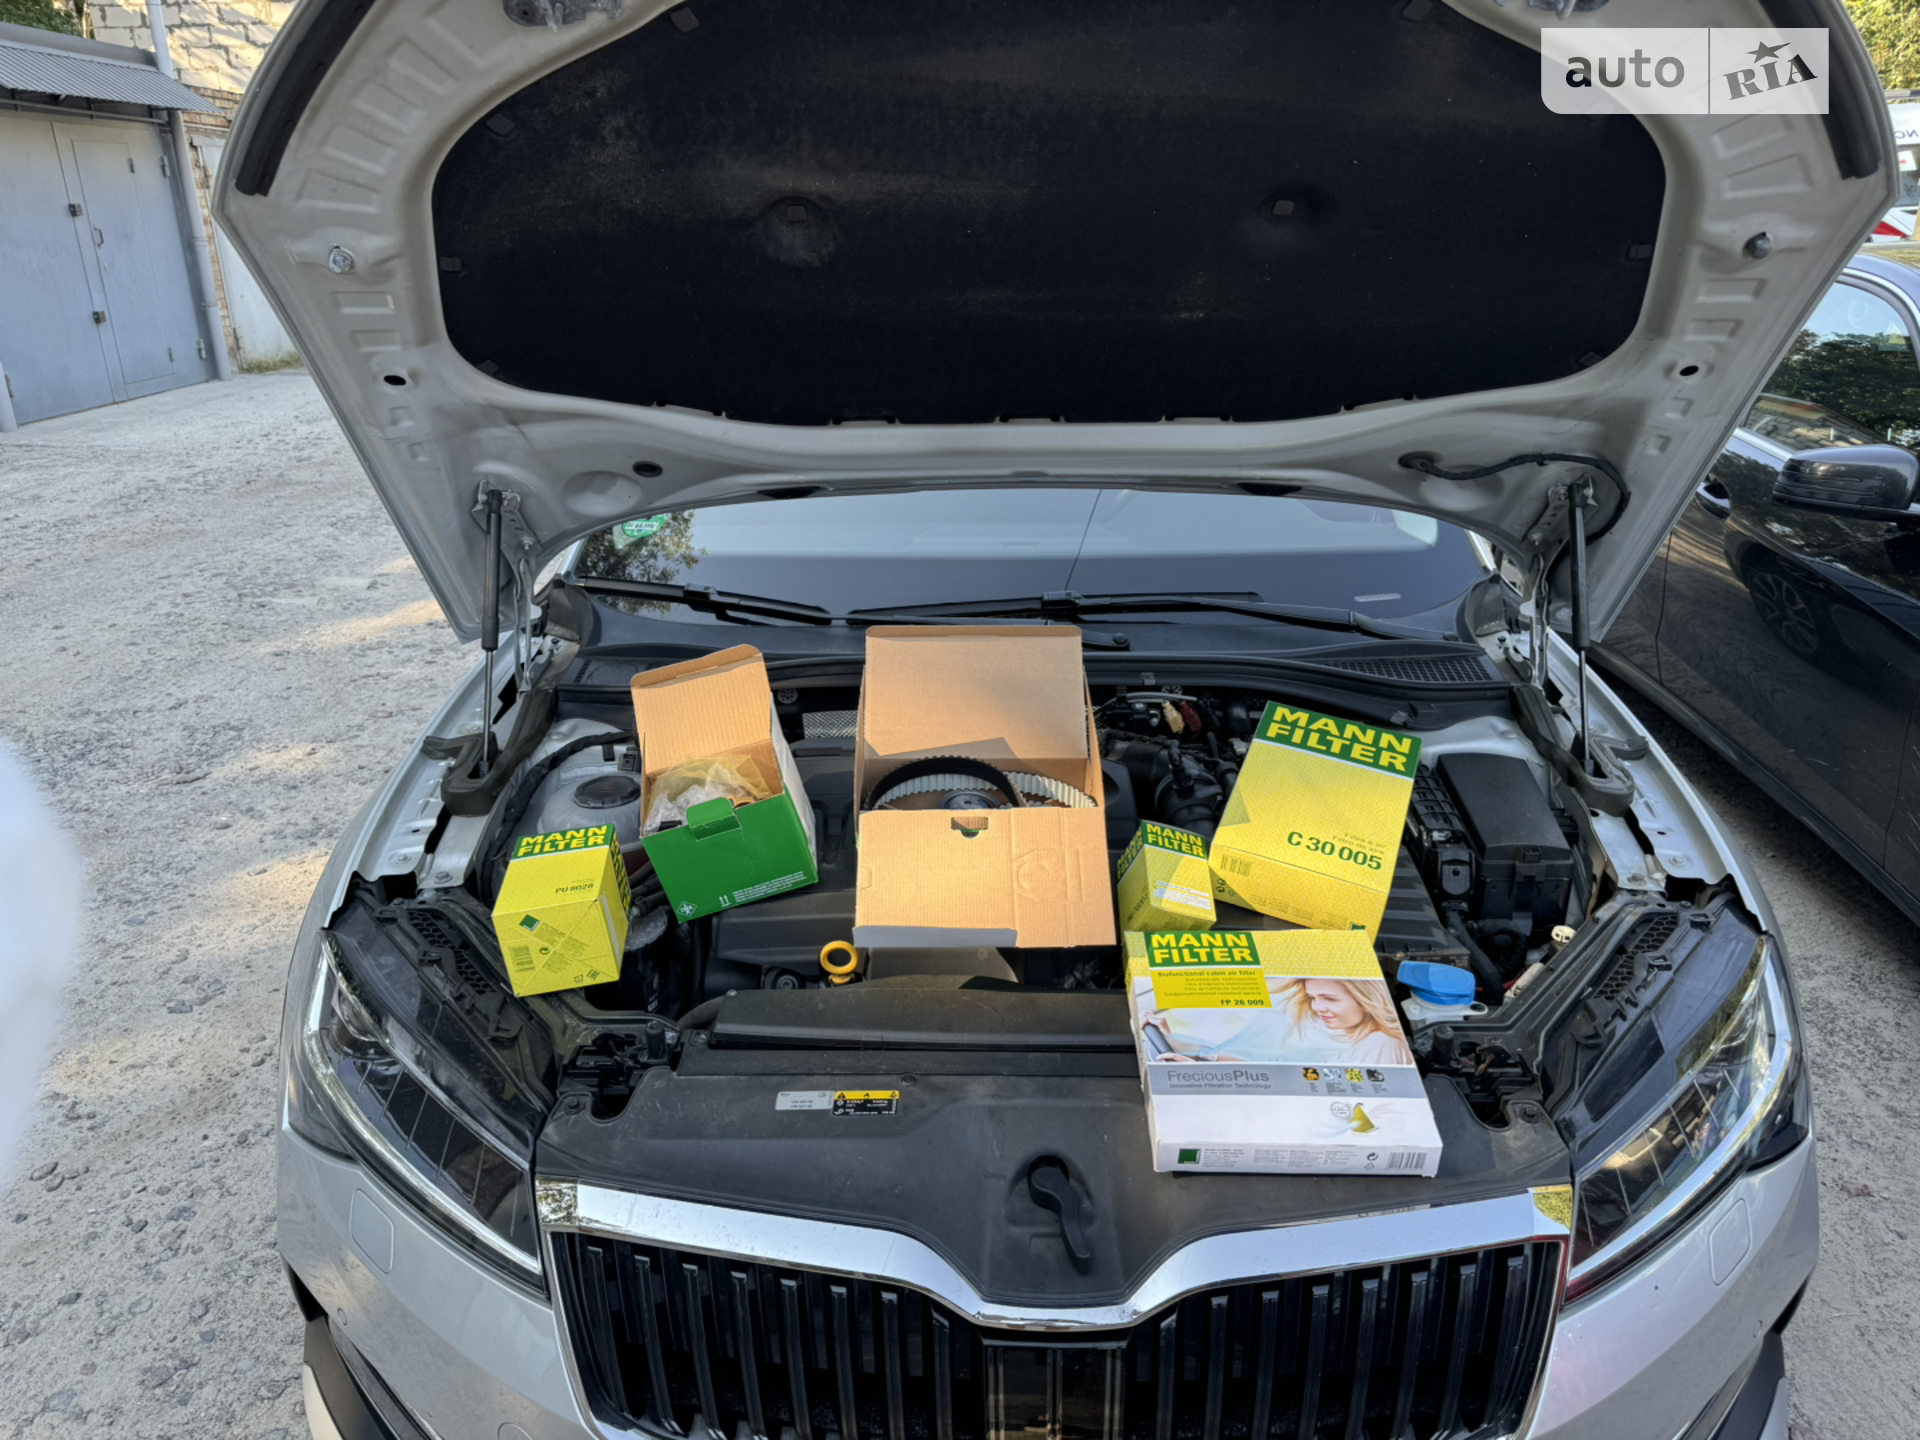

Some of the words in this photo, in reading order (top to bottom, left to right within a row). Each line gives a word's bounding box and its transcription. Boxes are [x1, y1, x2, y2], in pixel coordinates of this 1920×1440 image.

[1273, 706, 1412, 754] MANN
[1266, 722, 1408, 772] FILTER
[521, 825, 608, 846] MANN
[1146, 823, 1203, 846] MANN
[1148, 833, 1204, 857] FILTER
[517, 835, 604, 857] FILTER
[1287, 831, 1304, 846] C
[1305, 836, 1336, 856] 30
[1338, 846, 1383, 870] 005
[555, 886, 569, 894] PU
[1151, 933, 1249, 948] MANN
[1153, 948, 1254, 963] FILTER
[1167, 1069, 1270, 1082] FreciousPlus
